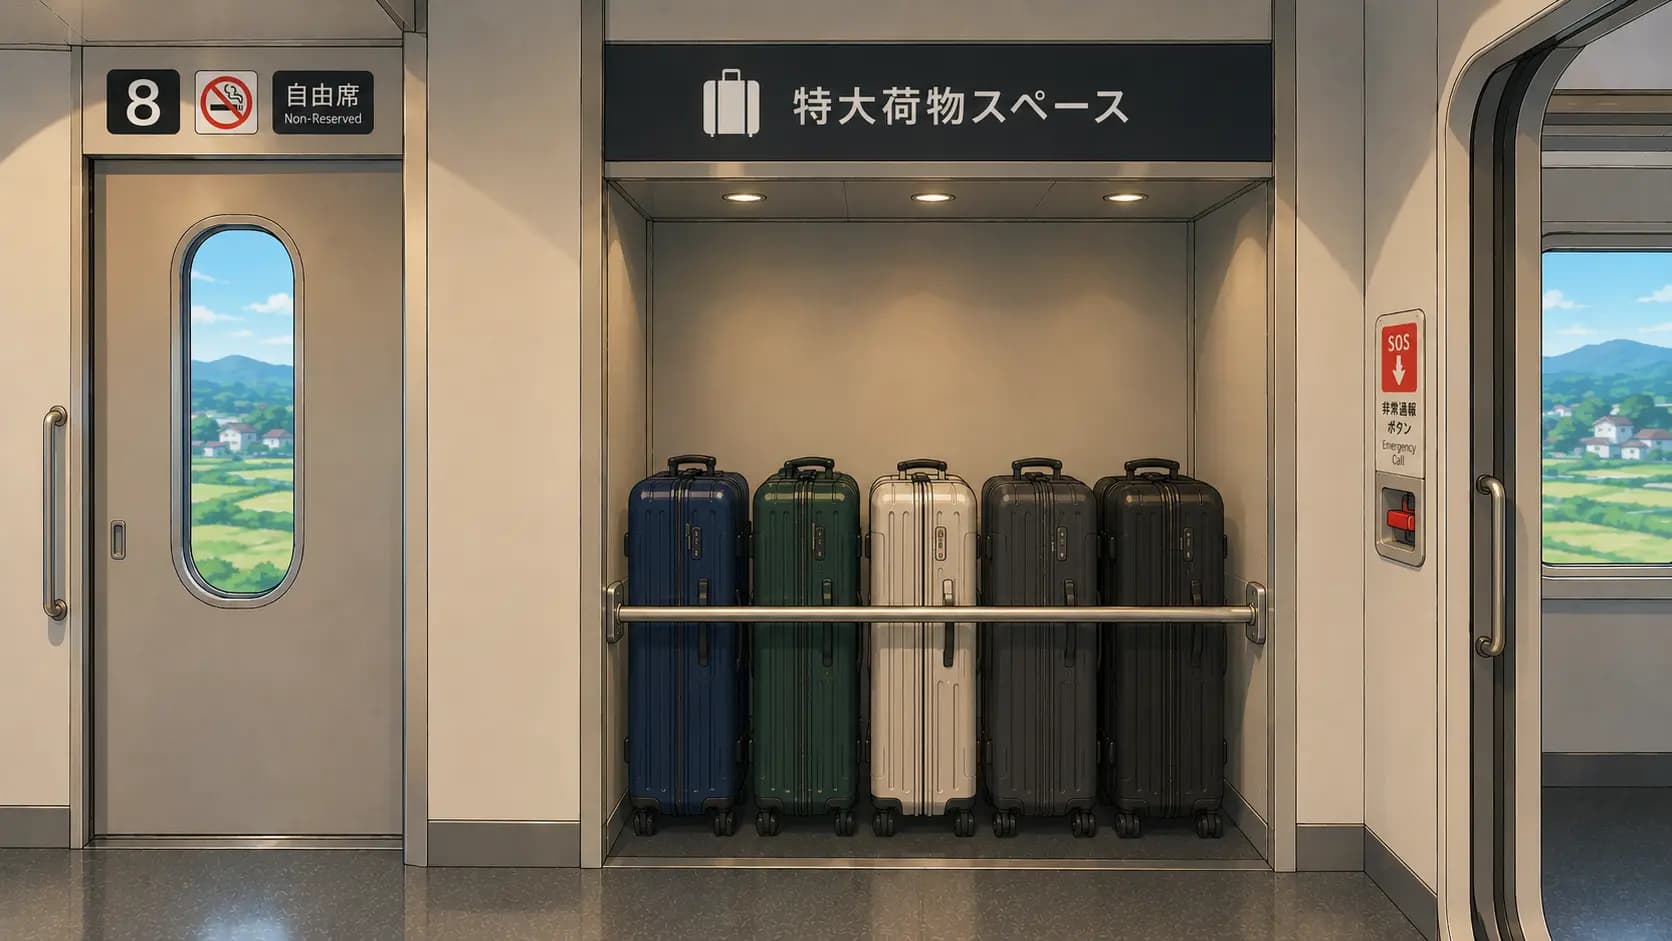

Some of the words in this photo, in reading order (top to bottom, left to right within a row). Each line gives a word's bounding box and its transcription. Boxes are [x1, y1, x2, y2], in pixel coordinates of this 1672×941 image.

[127, 79, 160, 126] 8
[287, 82, 360, 108] 自由席
[793, 86, 1129, 126] 特大荷物スペース
[285, 113, 362, 125] Non-Reserved
[1388, 333, 1410, 352] SOS
[1388, 420, 1412, 435] ボタン
[1382, 439, 1416, 455] Emergency
[1392, 454, 1405, 466] Call
